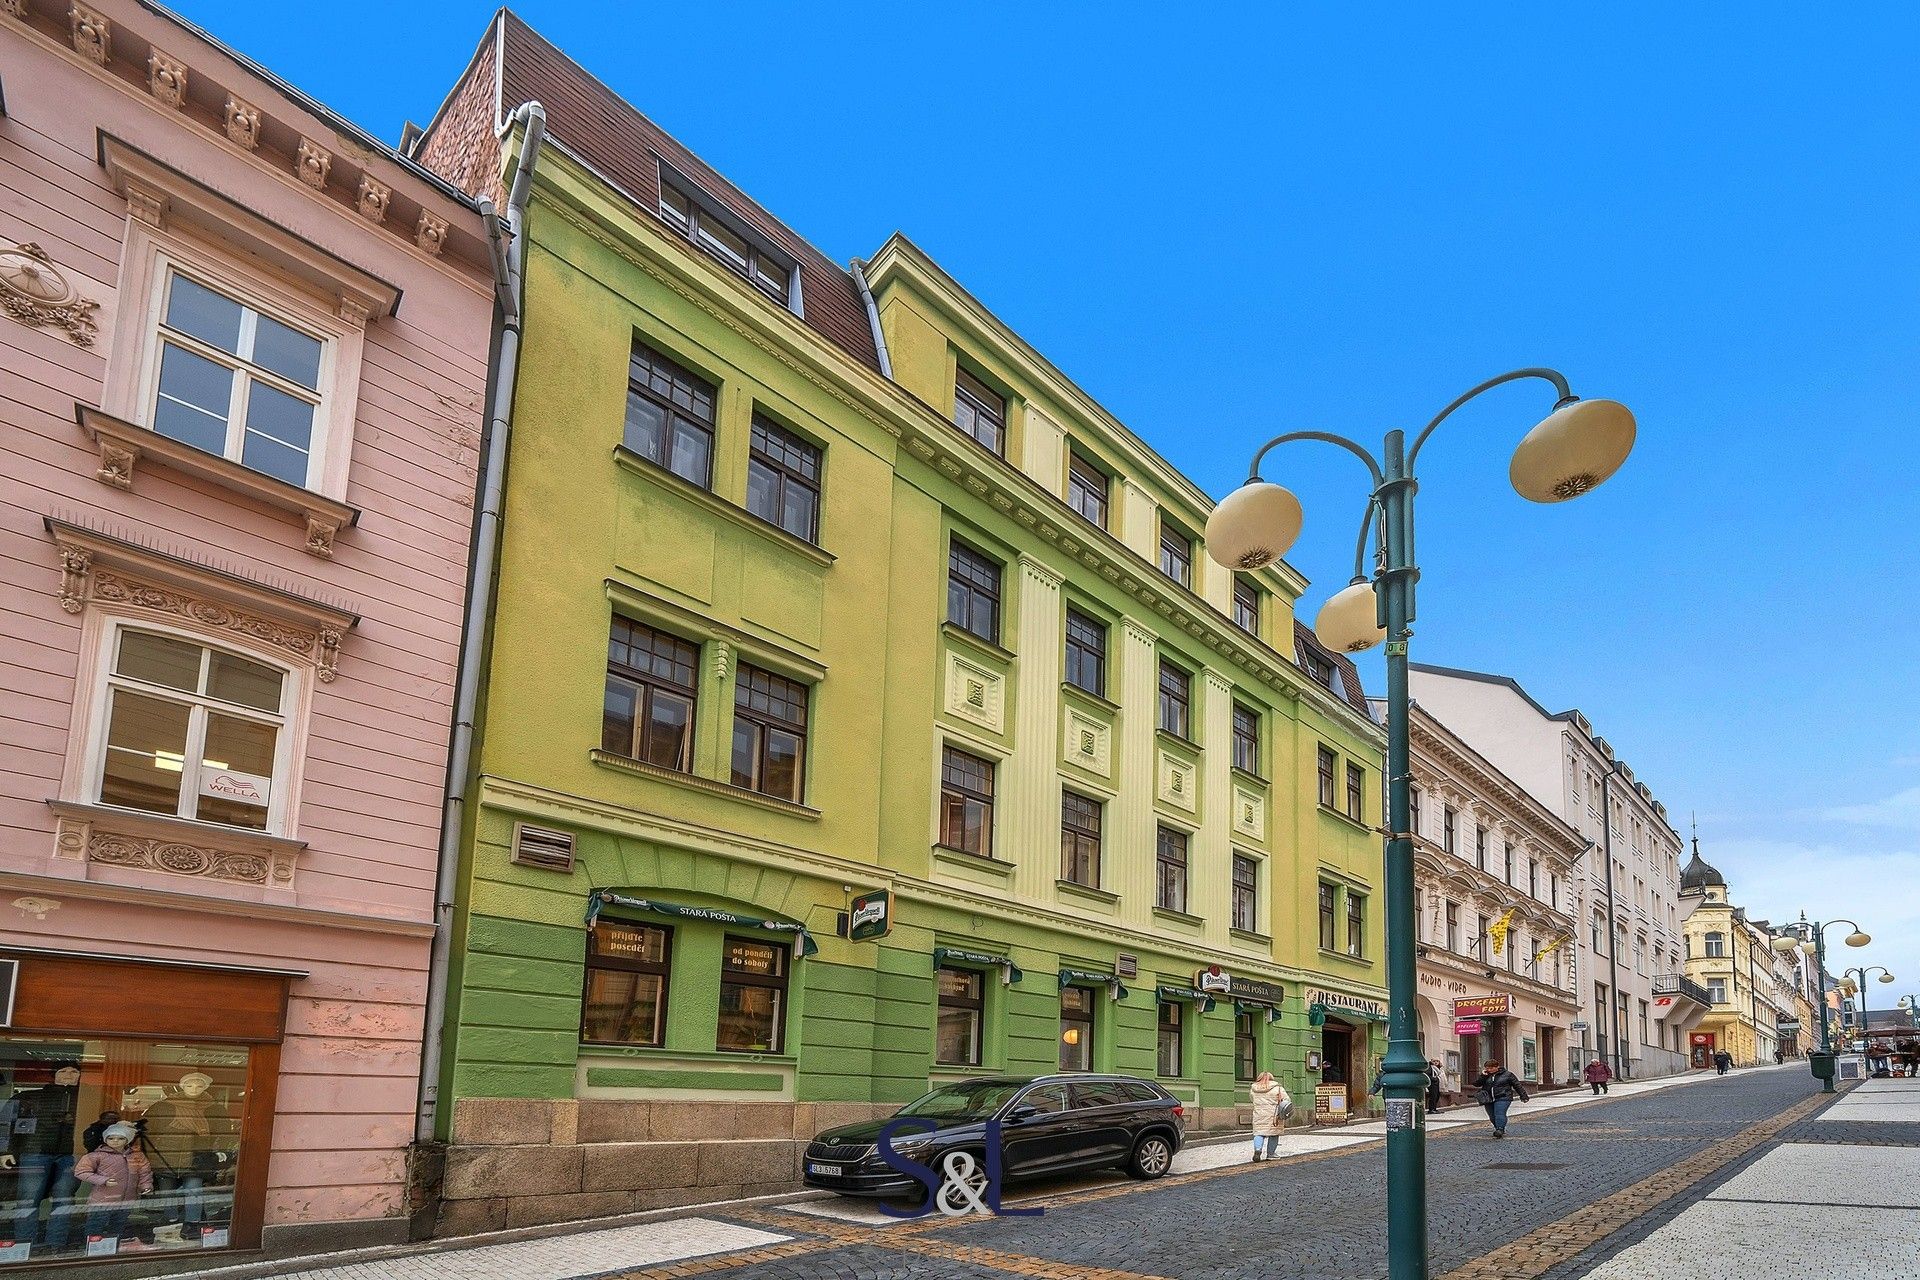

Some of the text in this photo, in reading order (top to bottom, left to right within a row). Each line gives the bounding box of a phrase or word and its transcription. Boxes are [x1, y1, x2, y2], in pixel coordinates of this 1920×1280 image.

[209, 783, 260, 799] WELLA
[680, 907, 737, 923] STARÁ POŠTA
[732, 947, 743, 956] od
[732, 957, 742, 965] do
[1232, 982, 1269, 996] STARÁ POŠTA
[1420, 973, 1441, 988] AUDIO
[1447, 980, 1467, 994] VIDEO
[1317, 991, 1379, 1015] RESTAURANT
[1456, 997, 1506, 1008] DROGERIE
[1481, 1005, 1507, 1013] FOTO
